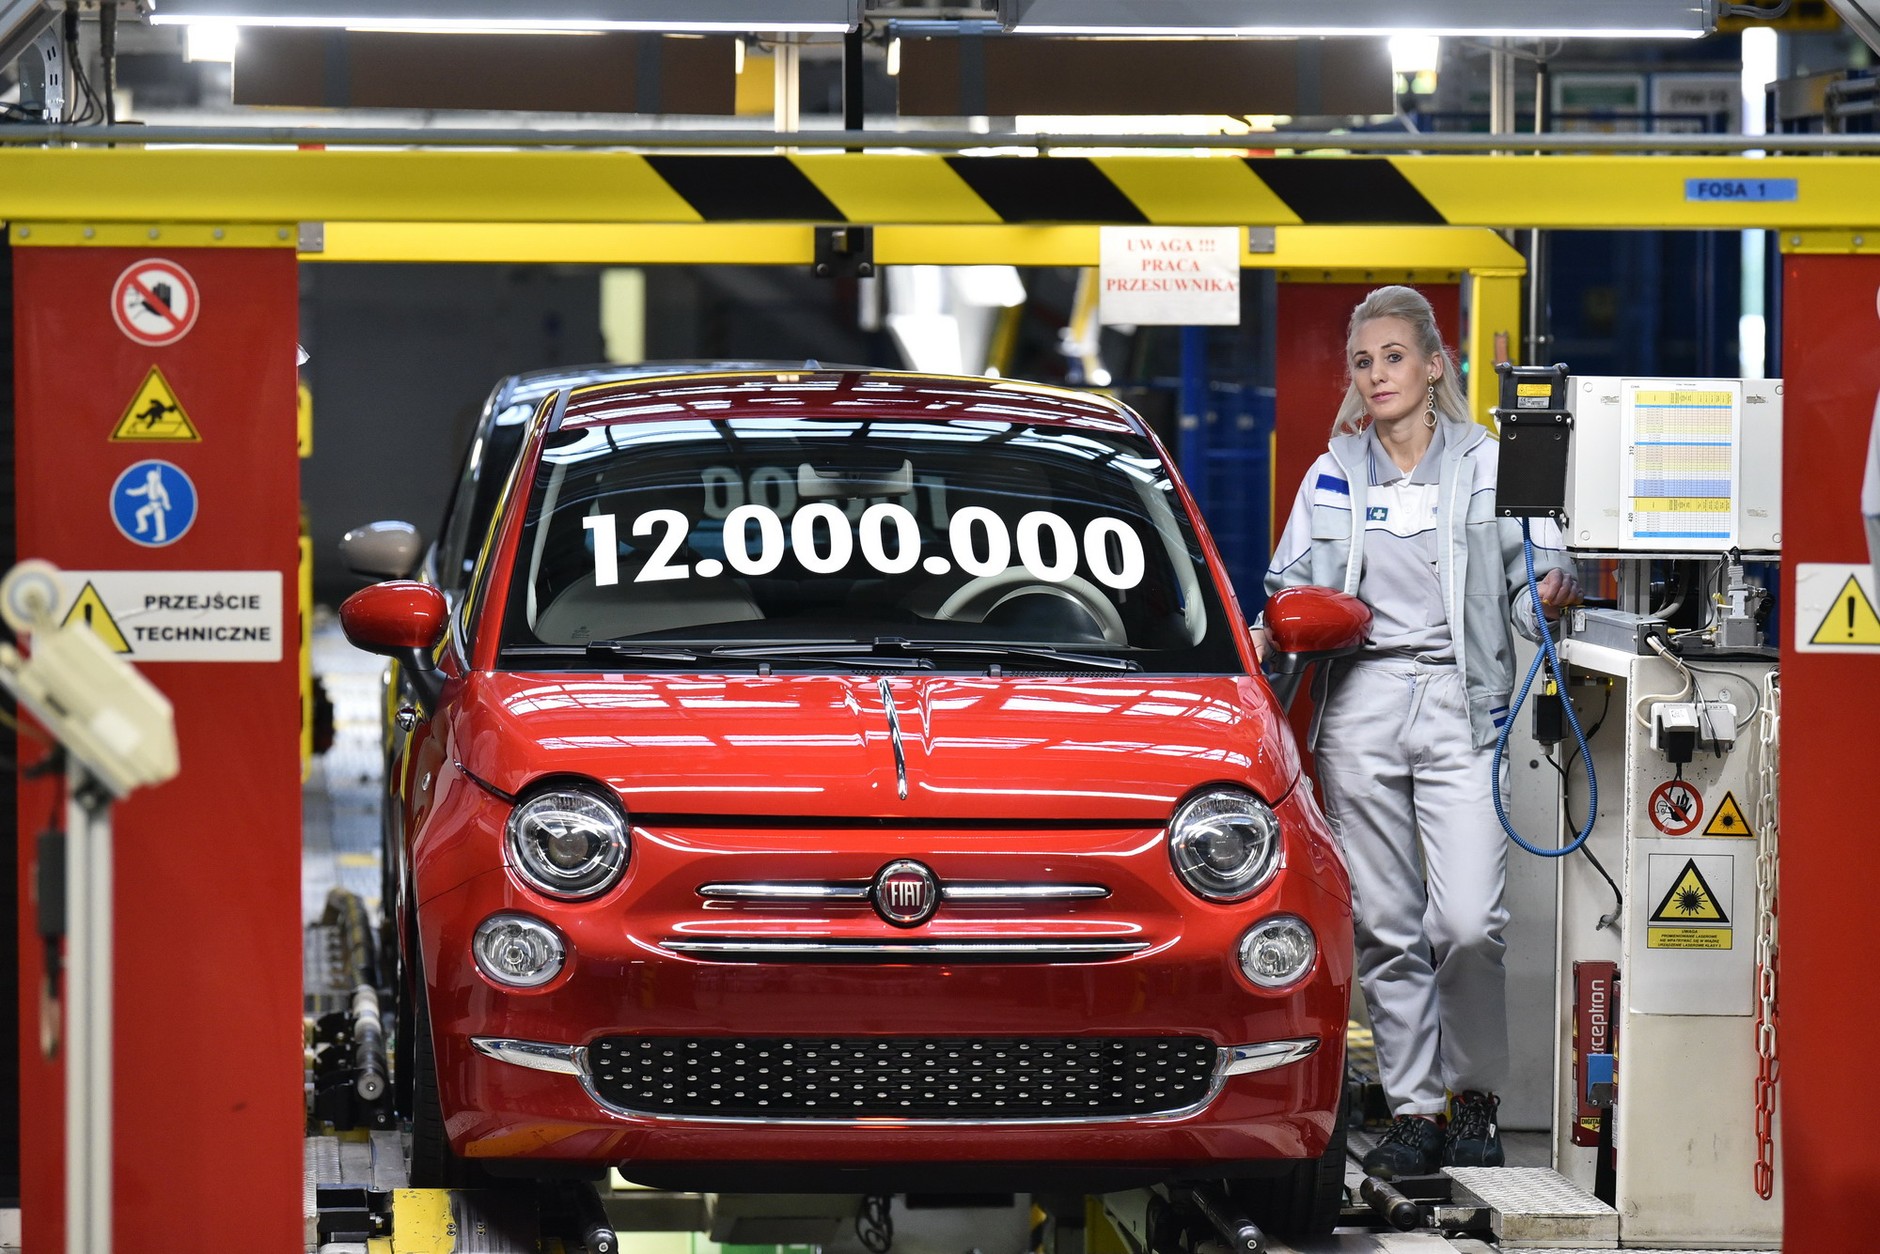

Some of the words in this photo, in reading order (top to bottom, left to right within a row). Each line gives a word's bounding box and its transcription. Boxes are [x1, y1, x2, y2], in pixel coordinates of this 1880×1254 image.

[1698, 182, 1747, 198] FOSA
[1757, 183, 1766, 198] 1
[1127, 239, 1194, 252] UWAGA
[1199, 239, 1215, 252] !!!
[1142, 259, 1201, 272] PRACA
[1106, 278, 1235, 292] PRZESUWNIKA
[582, 502, 1146, 591] 12.000.000
[144, 591, 261, 610] PRZEJŚCIE
[133, 627, 271, 641] TECHNICZNE
[891, 881, 923, 907] FIAT
[1588, 979, 1608, 1055] rceptron
